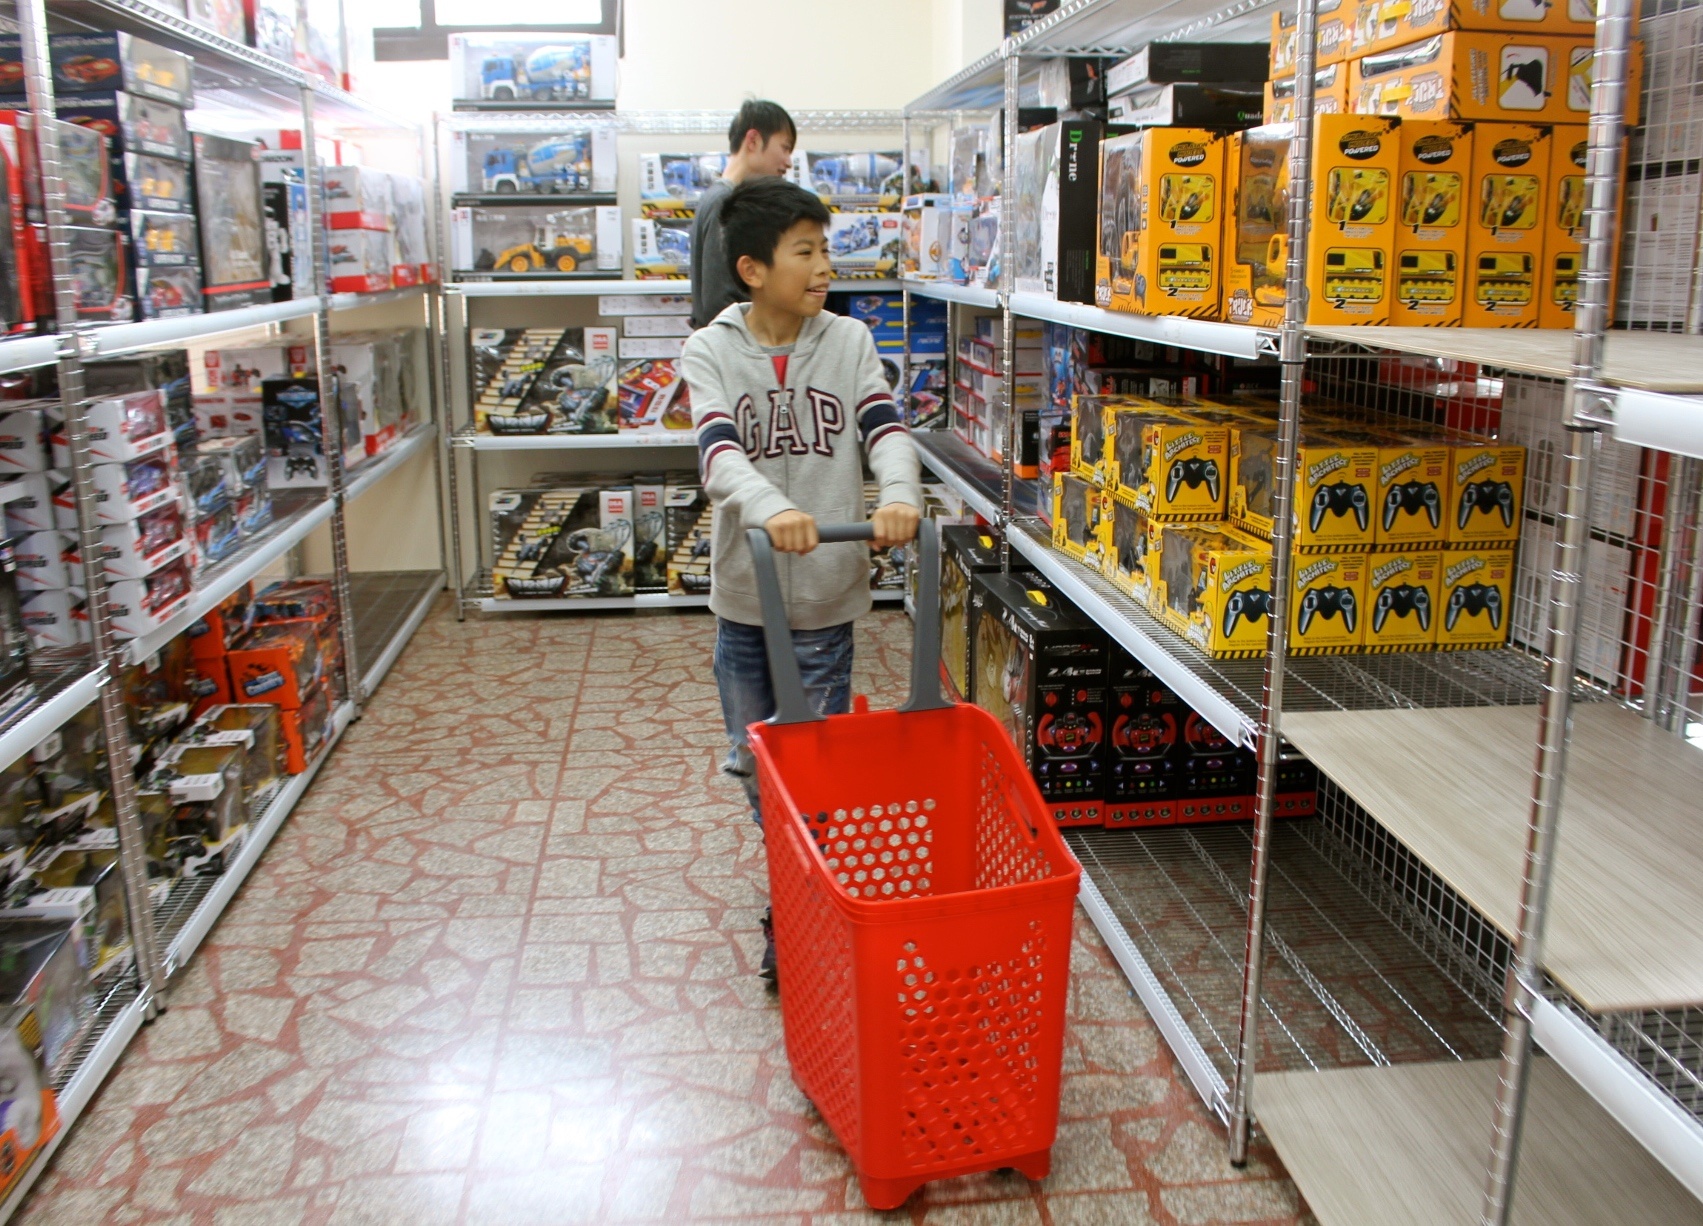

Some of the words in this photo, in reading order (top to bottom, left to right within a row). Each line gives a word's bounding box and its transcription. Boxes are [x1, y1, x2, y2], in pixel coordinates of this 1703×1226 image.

[1343, 145, 1379, 155] POWERED
[1417, 149, 1451, 160] POWERED
[1173, 154, 1205, 163] POWERED
[1496, 152, 1531, 163] POWERED
[1167, 287, 1178, 297] 2
[1228, 297, 1253, 317] TRUCK
[1334, 299, 1346, 309] 2
[1407, 300, 1419, 310] 2
[1485, 301, 1497, 311] 2
[1561, 301, 1573, 311] 2
[735, 386, 845, 462] GAP
[1165, 436, 1201, 460] ARCHITECT
[1223, 560, 1253, 580] LITTLE
[1222, 565, 1262, 591] ARCHITECT
